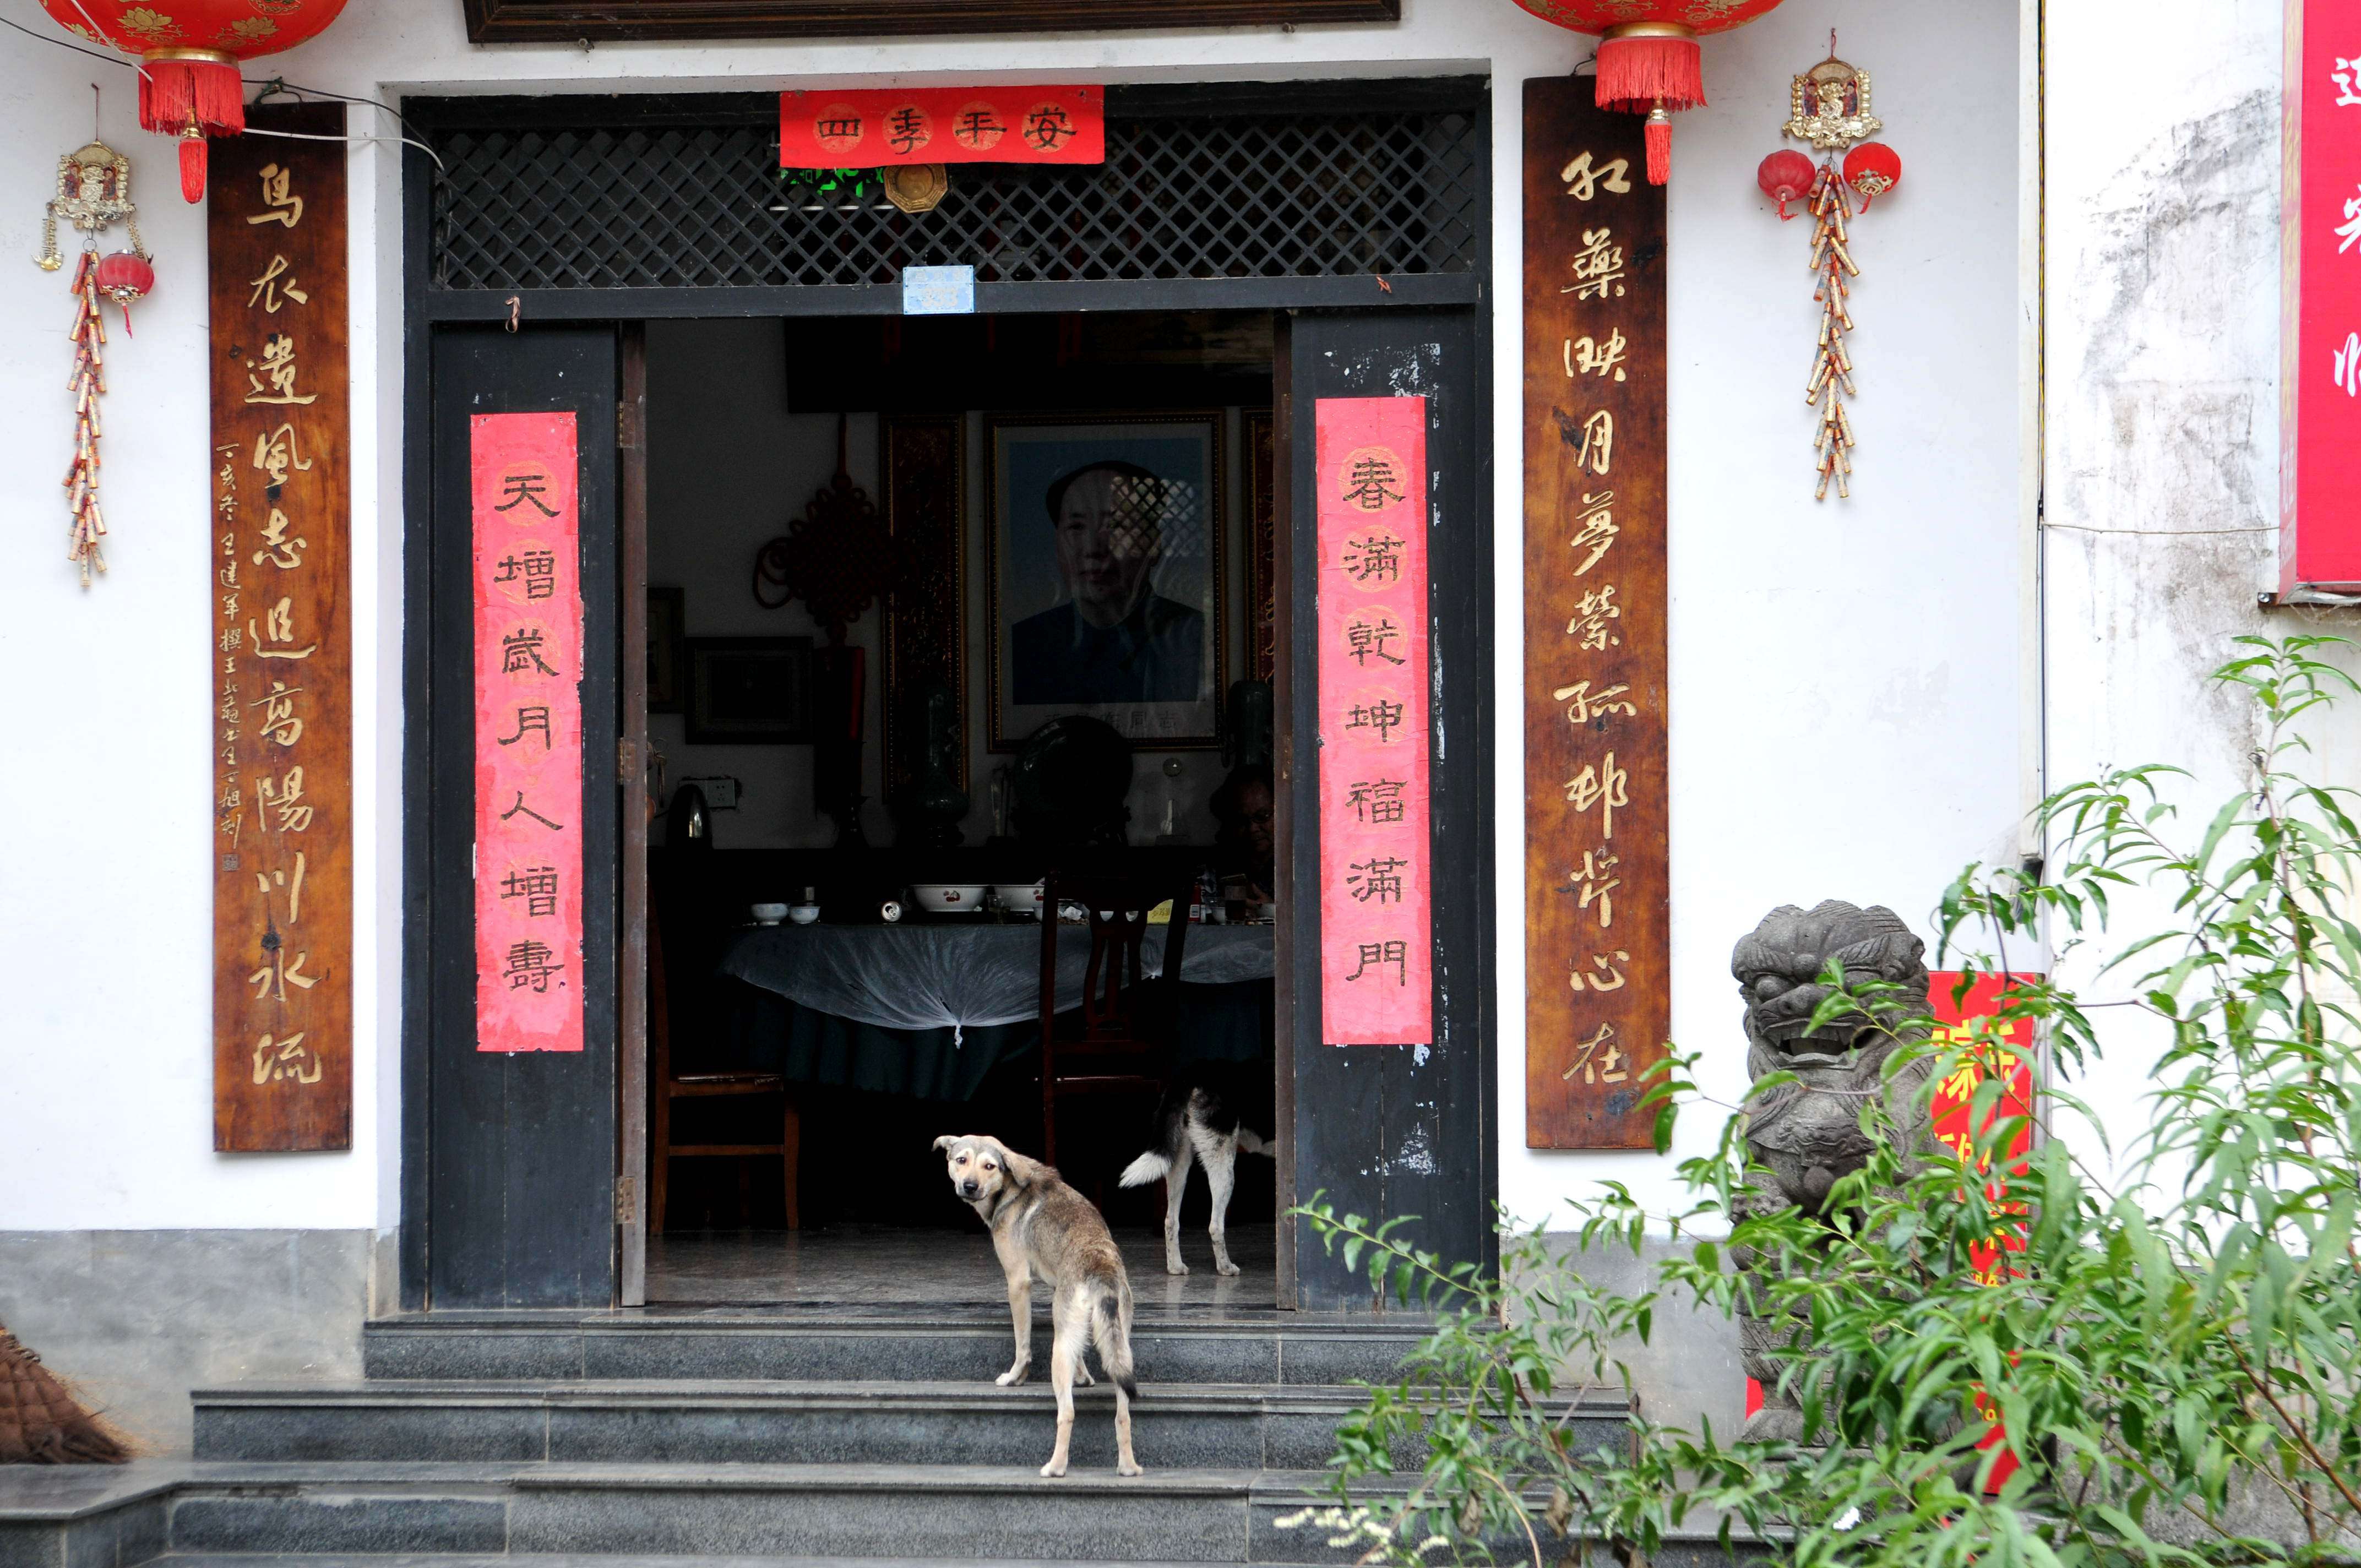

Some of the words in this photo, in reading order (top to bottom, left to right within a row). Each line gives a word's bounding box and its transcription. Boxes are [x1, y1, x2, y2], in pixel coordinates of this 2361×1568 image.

[815, 107, 1078, 155] 四季平安
[494, 475, 565, 994] 天增歲月人增壽
[1343, 457, 1409, 987] 春滿乾坤福滿門
